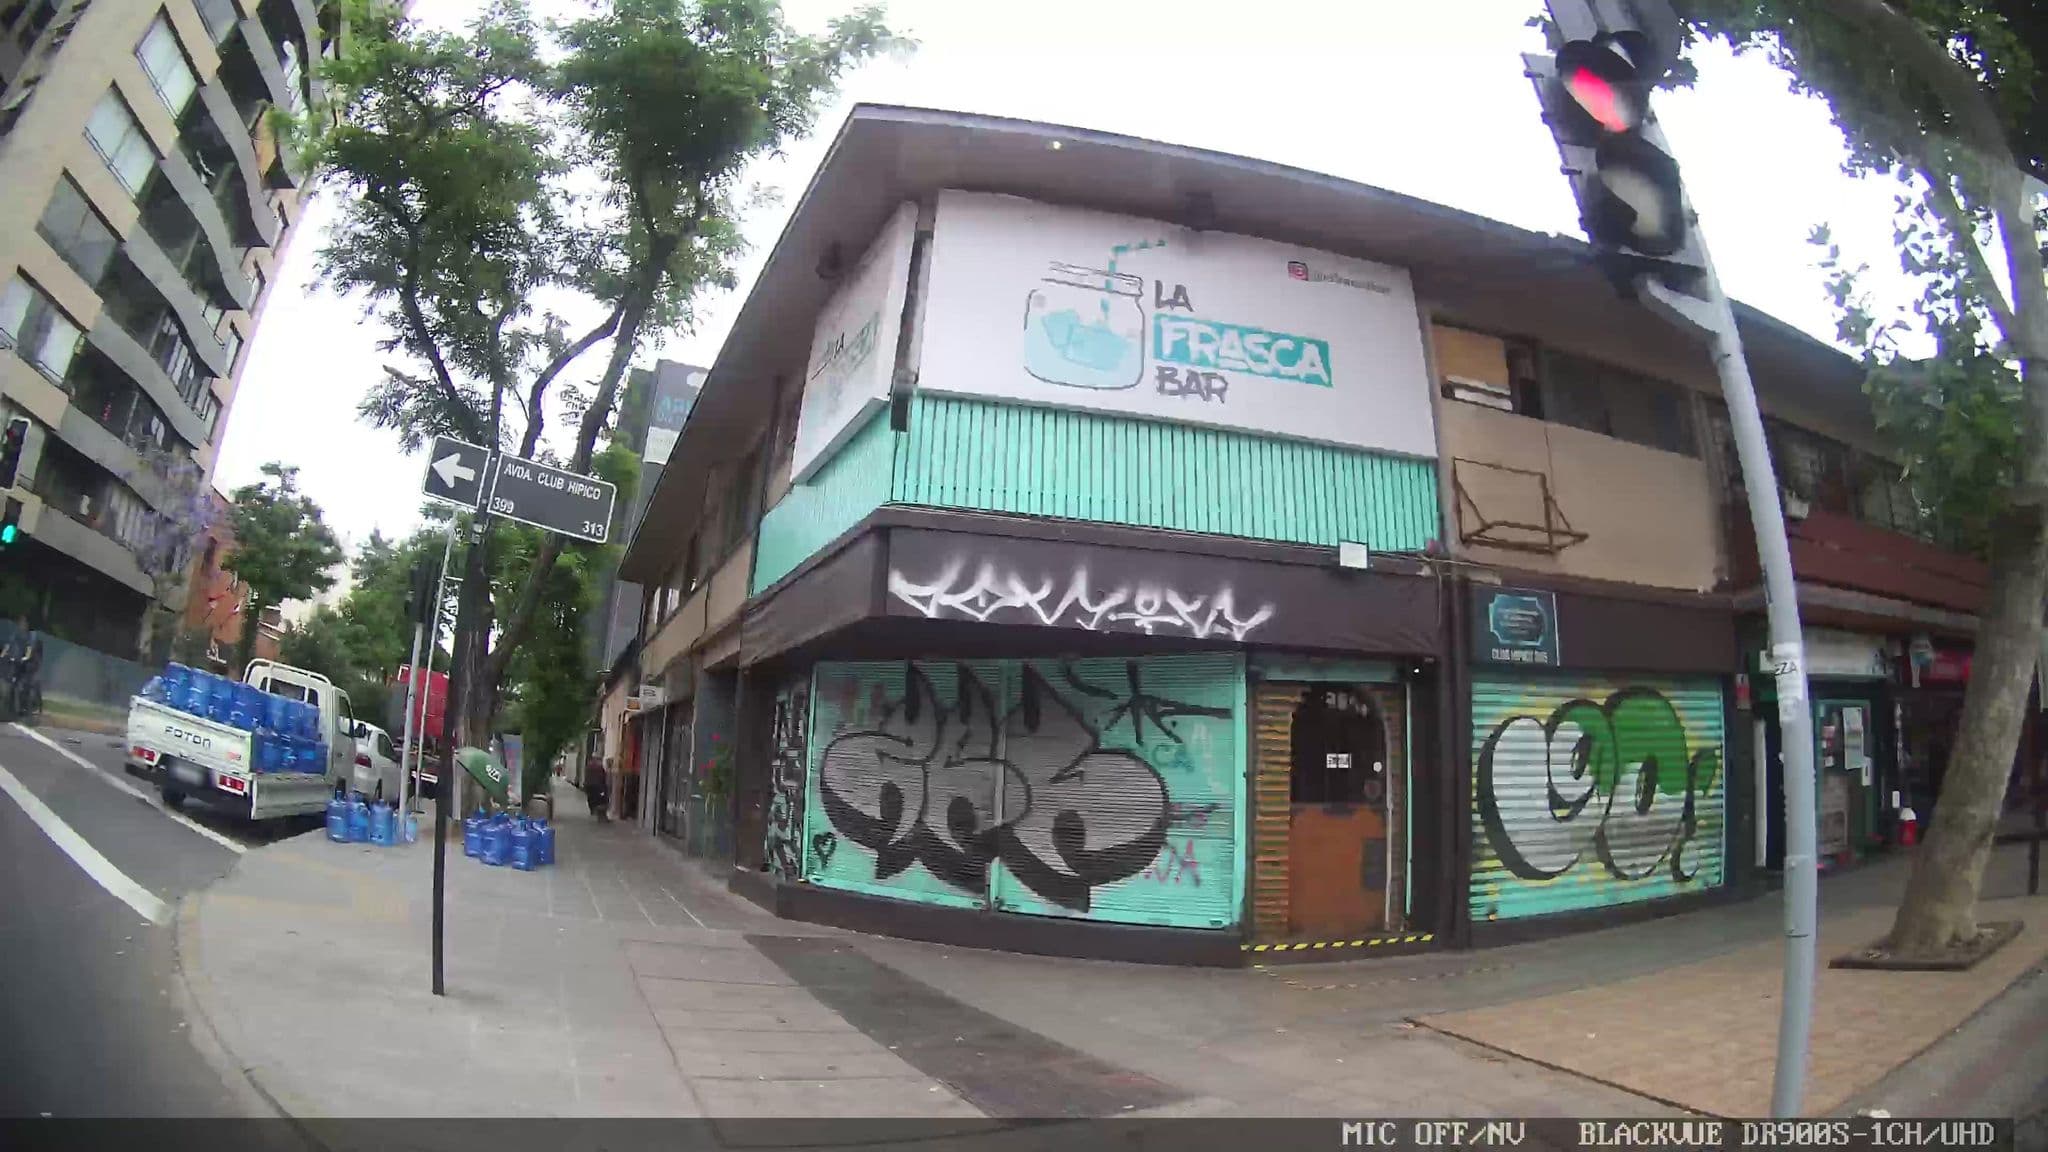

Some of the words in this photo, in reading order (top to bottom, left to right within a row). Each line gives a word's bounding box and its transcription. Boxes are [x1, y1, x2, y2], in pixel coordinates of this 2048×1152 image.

[1155, 279, 1194, 312] LA
[1157, 317, 1331, 386] FRASCA
[1155, 364, 1229, 404] BAR
[503, 462, 533, 482] AVDA.
[537, 471, 565, 491] CLUB
[567, 481, 601, 500] HIPICO
[493, 497, 515, 514] 399
[582, 520, 604, 537] 313
[164, 725, 212, 749] FOTON
